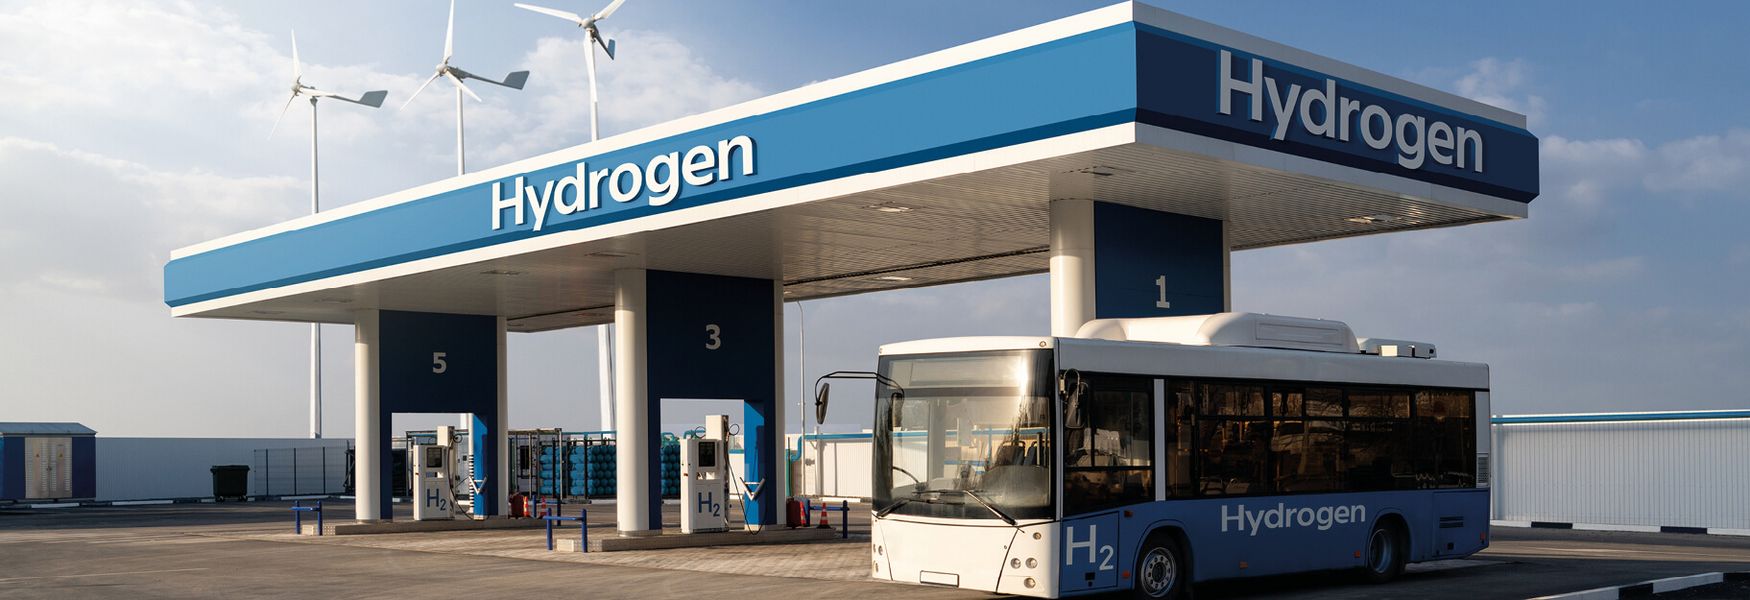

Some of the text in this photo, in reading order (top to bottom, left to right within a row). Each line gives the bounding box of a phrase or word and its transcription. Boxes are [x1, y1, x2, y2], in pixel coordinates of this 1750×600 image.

[1219, 49, 1483, 172] Hydrogen
[491, 134, 755, 231] Hydrogen
[1155, 275, 1170, 308] 1
[705, 324, 721, 350] 3
[432, 352, 447, 374] 5
[426, 488, 446, 512] H2
[698, 492, 721, 518] H2
[1221, 502, 1366, 536] Hydrogen
[1065, 524, 1114, 571] H2
